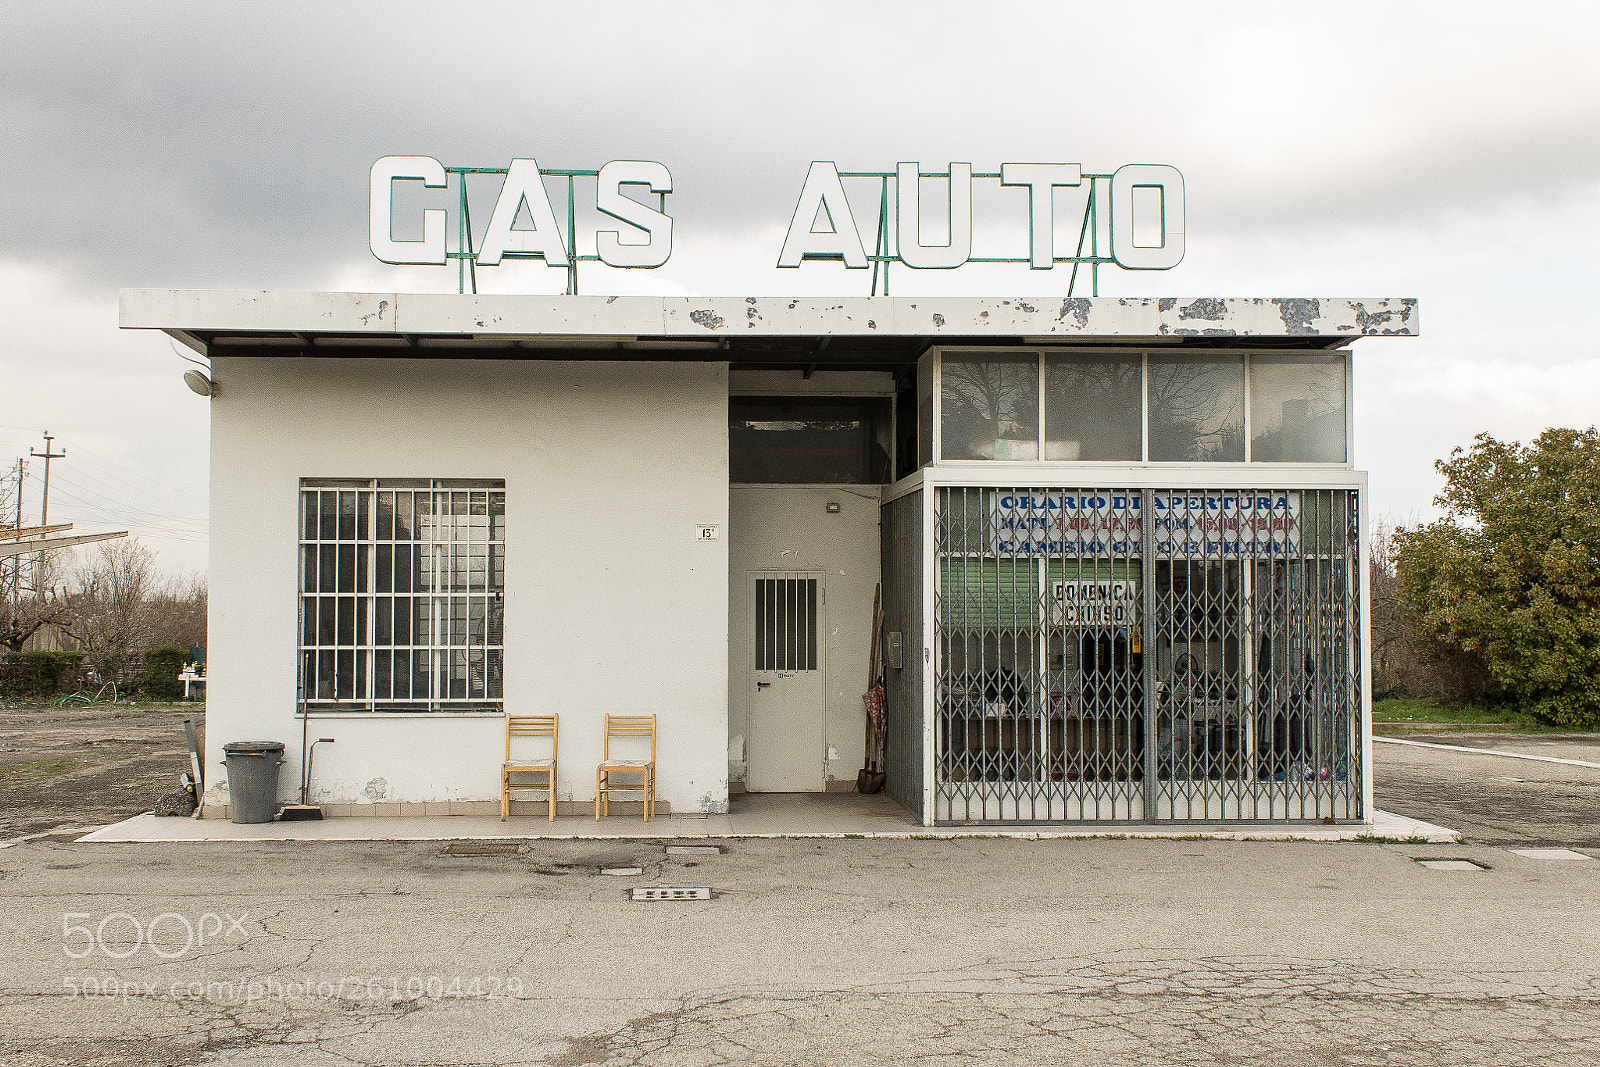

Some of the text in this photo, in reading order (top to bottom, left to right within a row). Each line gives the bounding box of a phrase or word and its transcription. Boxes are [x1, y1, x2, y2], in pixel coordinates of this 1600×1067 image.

[369, 155, 1186, 270] GAS AUTO
[1000, 495, 1293, 511] ORARIO DI APERTURA
[999, 541, 1106, 554] CAMBIO
[1112, 541, 1176, 554] OLO
[1183, 541, 1200, 554] E
[1056, 584, 1134, 601] DOMENCA
